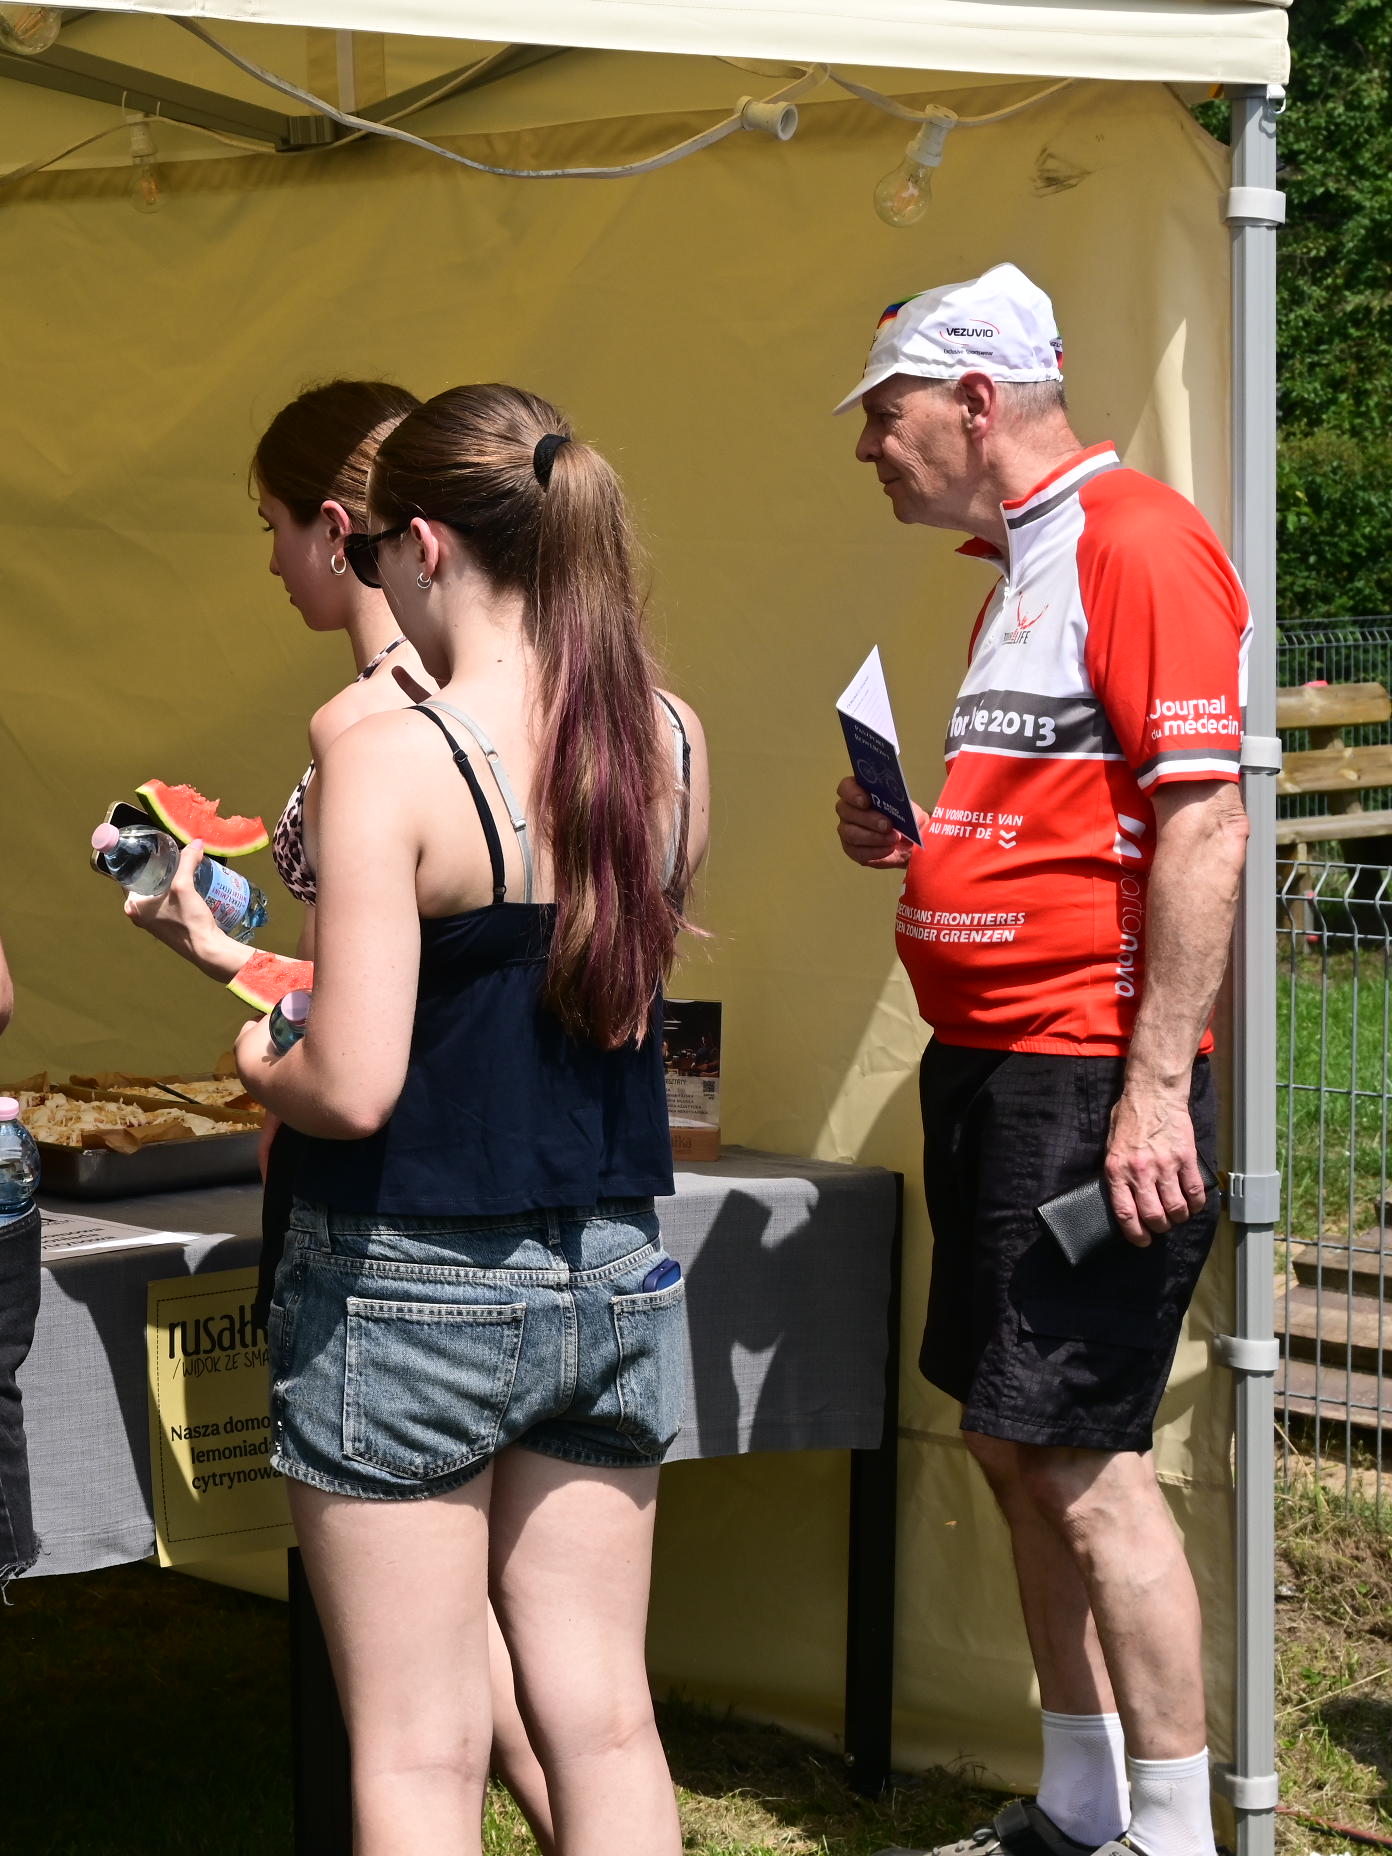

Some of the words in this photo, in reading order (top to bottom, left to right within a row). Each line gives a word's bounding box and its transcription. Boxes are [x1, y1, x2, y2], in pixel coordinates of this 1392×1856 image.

[946, 327, 993, 338] VEZUVIO
[1150, 694, 1226, 719] Journal
[950, 706, 969, 737] for
[1151, 728, 1162, 740] du
[1163, 715, 1239, 736] médecin
[945, 808, 994, 824] VOORDELE
[998, 813, 1024, 826] VAN
[929, 822, 941, 834] AU
[941, 824, 973, 838] PROFIT
[976, 827, 993, 839] DE
[913, 908, 933, 923] SANS
[934, 912, 1025, 925] FRONTIERES
[906, 924, 937, 941] ZONDER
[939, 929, 1016, 943] GRENZEN
[168, 1303, 269, 1359] rusałk
[225, 1352, 241, 1371] ZE
[244, 1347, 270, 1368] SMA
[171, 1422, 221, 1442] Nasza
[224, 1415, 271, 1434] domo
[191, 1436, 272, 1464] lemoniad
